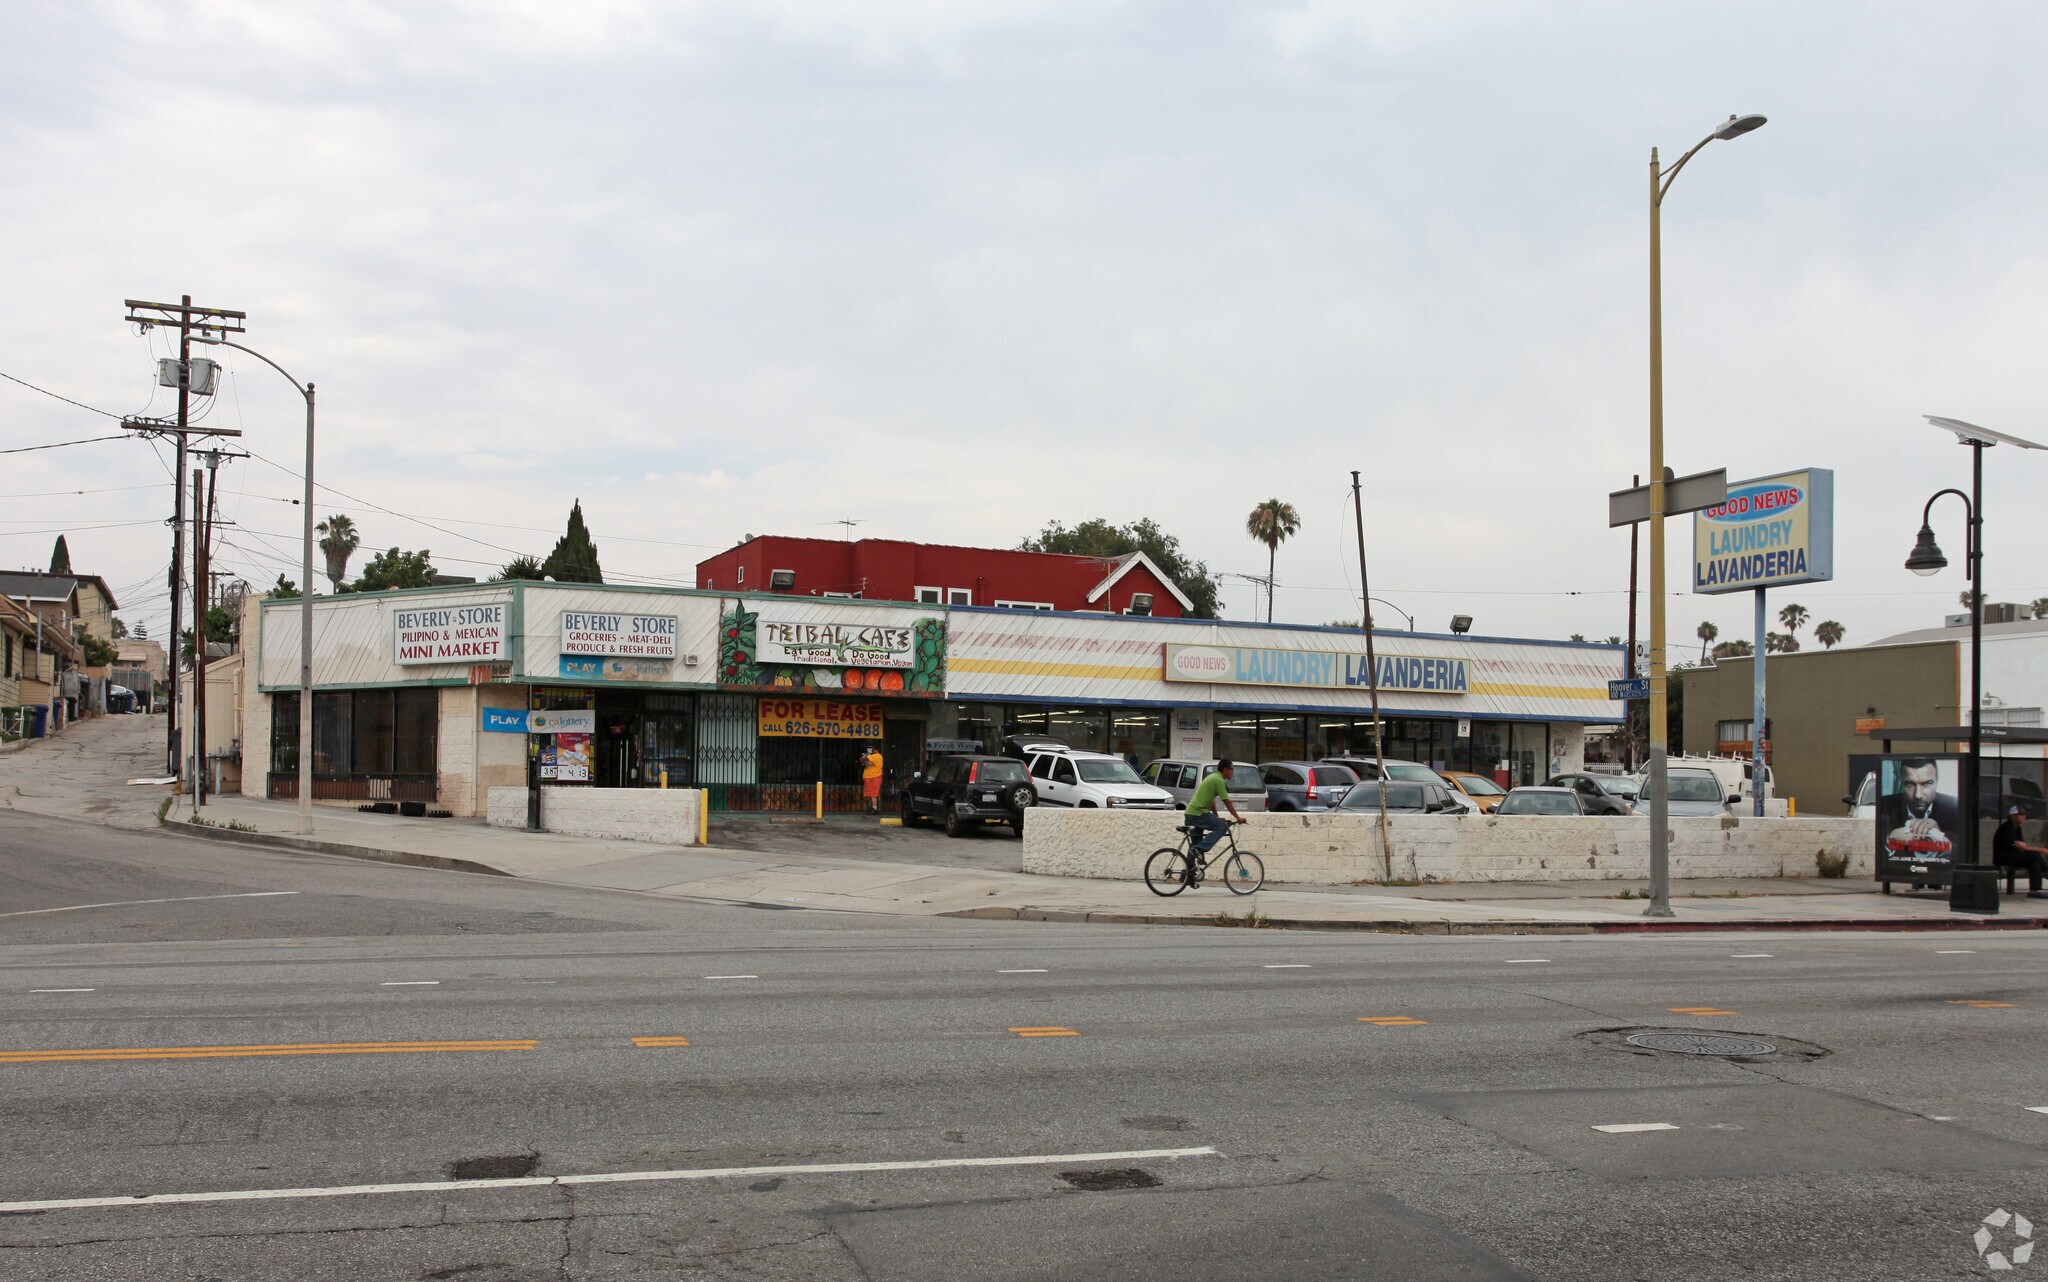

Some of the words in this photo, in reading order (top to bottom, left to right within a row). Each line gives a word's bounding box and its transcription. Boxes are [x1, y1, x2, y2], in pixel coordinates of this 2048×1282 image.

[1754, 488, 1798, 510] NEWS
[1710, 519, 1793, 556] LAUNDRY
[1697, 548, 1807, 586] LAVANDERIA
[398, 611, 452, 628] BEVERLY
[458, 607, 502, 625] STORE
[566, 614, 621, 632] BEVERLY
[632, 617, 674, 634] STORE
[402, 630, 440, 642] PILIPINO
[443, 630, 450, 640] &
[455, 627, 498, 639] MEXICAN
[570, 632, 616, 642] GROCERIES
[628, 634, 670, 644] MEAT-DELI
[765, 624, 844, 644] TRIBAL
[400, 645, 432, 659] MINI
[438, 641, 500, 657] MARKET
[566, 642, 606, 652] PRODUCE
[620, 645, 644, 654] FRESH
[646, 646, 672, 655] FRUITS
[784, 646, 802, 654] Eat
[808, 647, 831, 656] Good
[852, 650, 864, 658] Do
[868, 650, 890, 660] Good
[566, 662, 596, 672] PLAY
[1178, 656, 1200, 669] GOOD
[1203, 658, 1226, 670] NEWS
[1236, 649, 1334, 685] LAUNDRY
[1345, 654, 1467, 690] LAVANDERIA
[1610, 682, 1632, 692] Hoover
[1641, 680, 1648, 690] St
[490, 714, 520, 726] PLAY
[762, 701, 804, 718] FOR
[814, 702, 880, 722] LEASE
[762, 724, 783, 732] CALL
[786, 721, 880, 737] 626-570-4488
